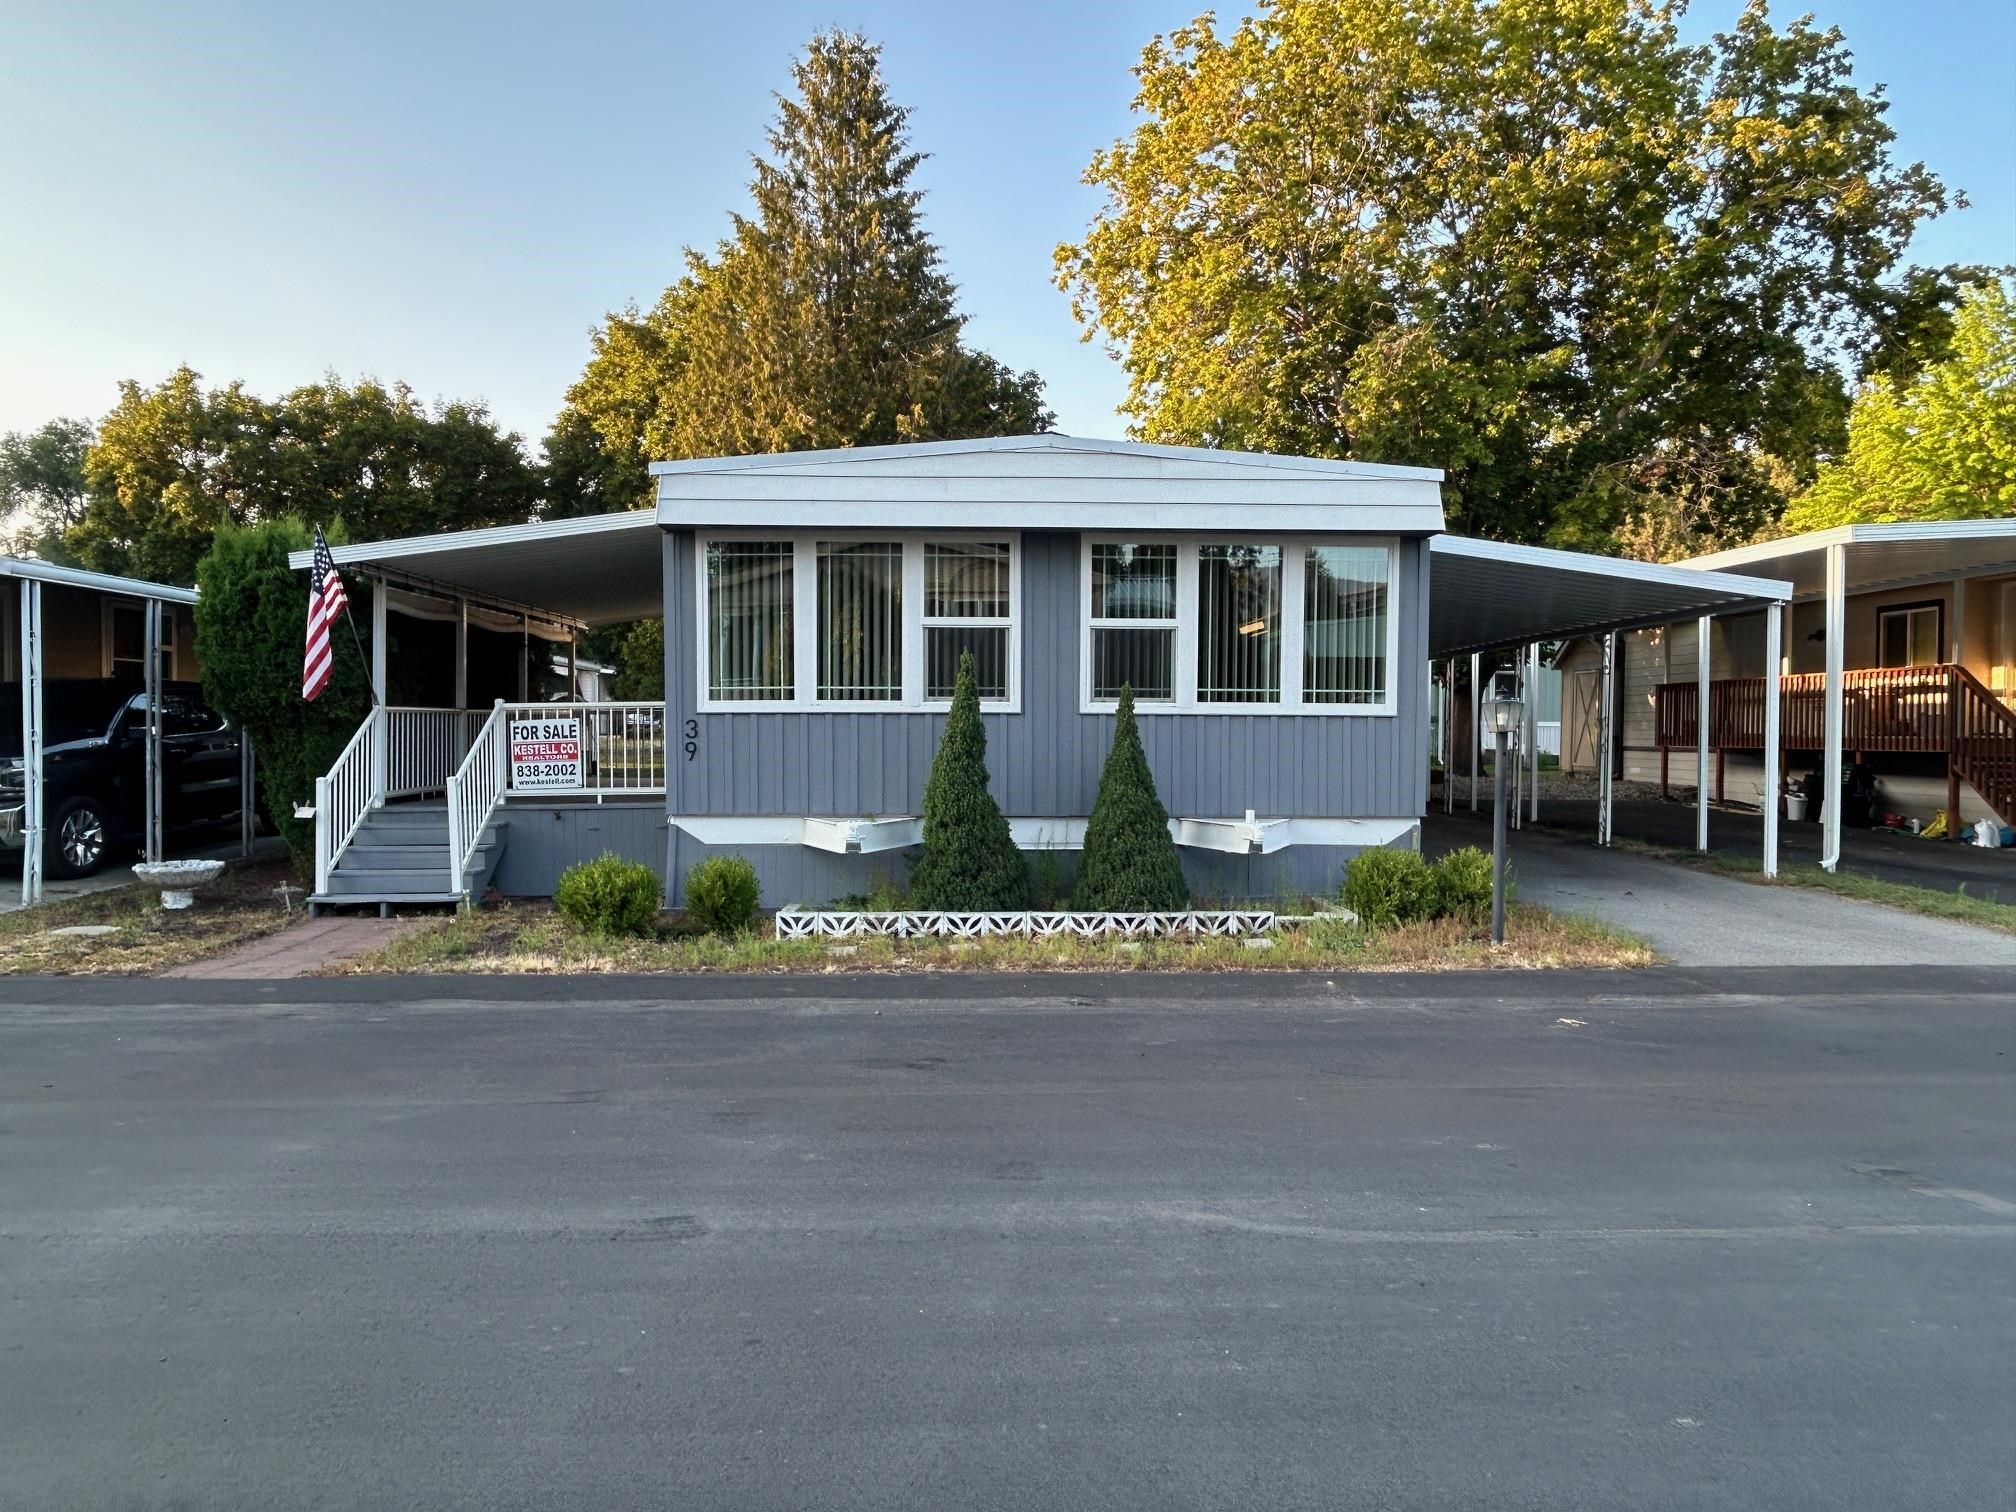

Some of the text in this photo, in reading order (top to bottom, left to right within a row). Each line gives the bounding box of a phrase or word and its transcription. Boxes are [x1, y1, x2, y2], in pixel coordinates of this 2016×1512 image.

[513, 724, 577, 740] FOR SALE
[514, 743, 577, 755] KESTELL CO.
[517, 764, 576, 777] 838-2002
